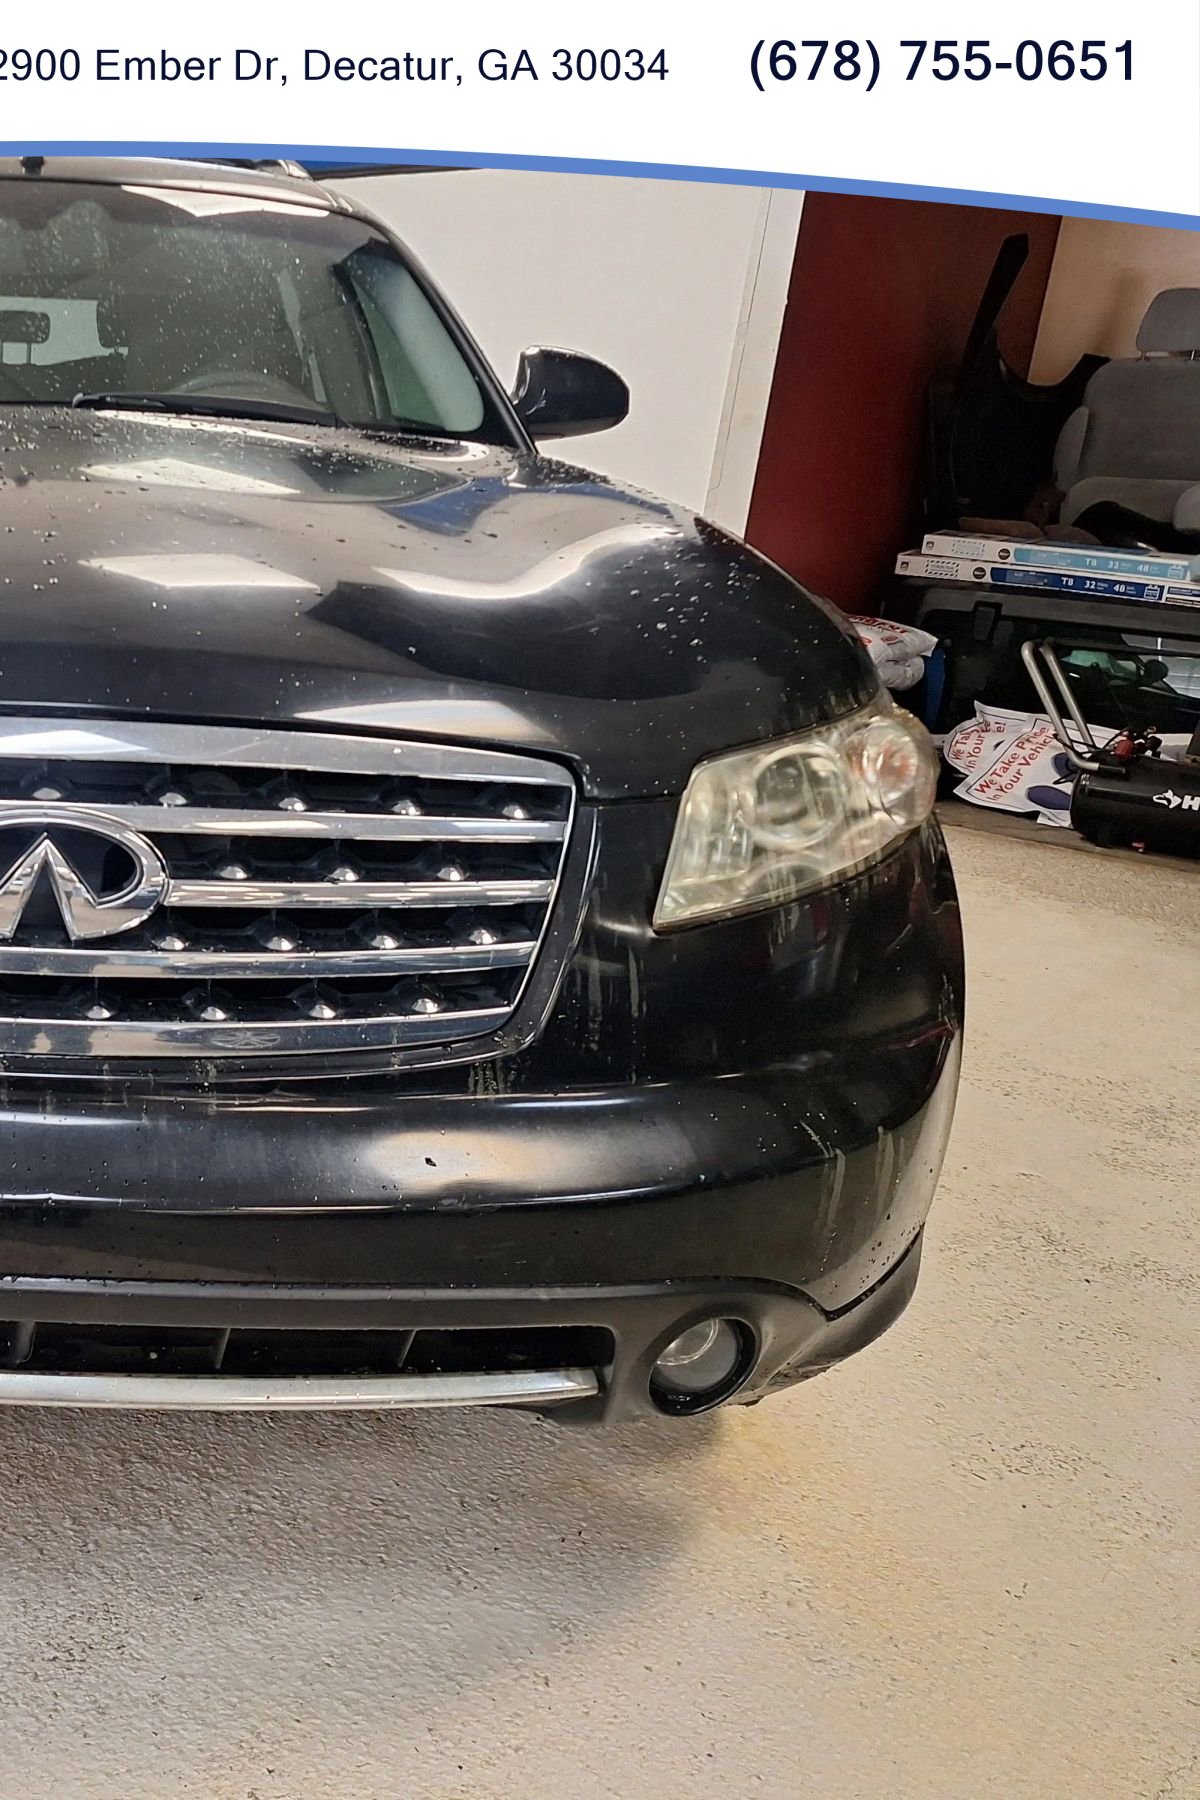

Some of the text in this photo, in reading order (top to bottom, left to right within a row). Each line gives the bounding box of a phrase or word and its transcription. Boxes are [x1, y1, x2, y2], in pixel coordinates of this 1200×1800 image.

[1108, 560, 1119, 569] 32
[1136, 564, 1149, 573] 48
[1084, 580, 1096, 589] 32
[1113, 583, 1126, 593] 48
[951, 746, 965, 761] We
[965, 733, 986, 769] In Your
[974, 778, 998, 795] We
[990, 752, 1020, 778] Take
[986, 734, 1056, 802] In Your Vehicl
